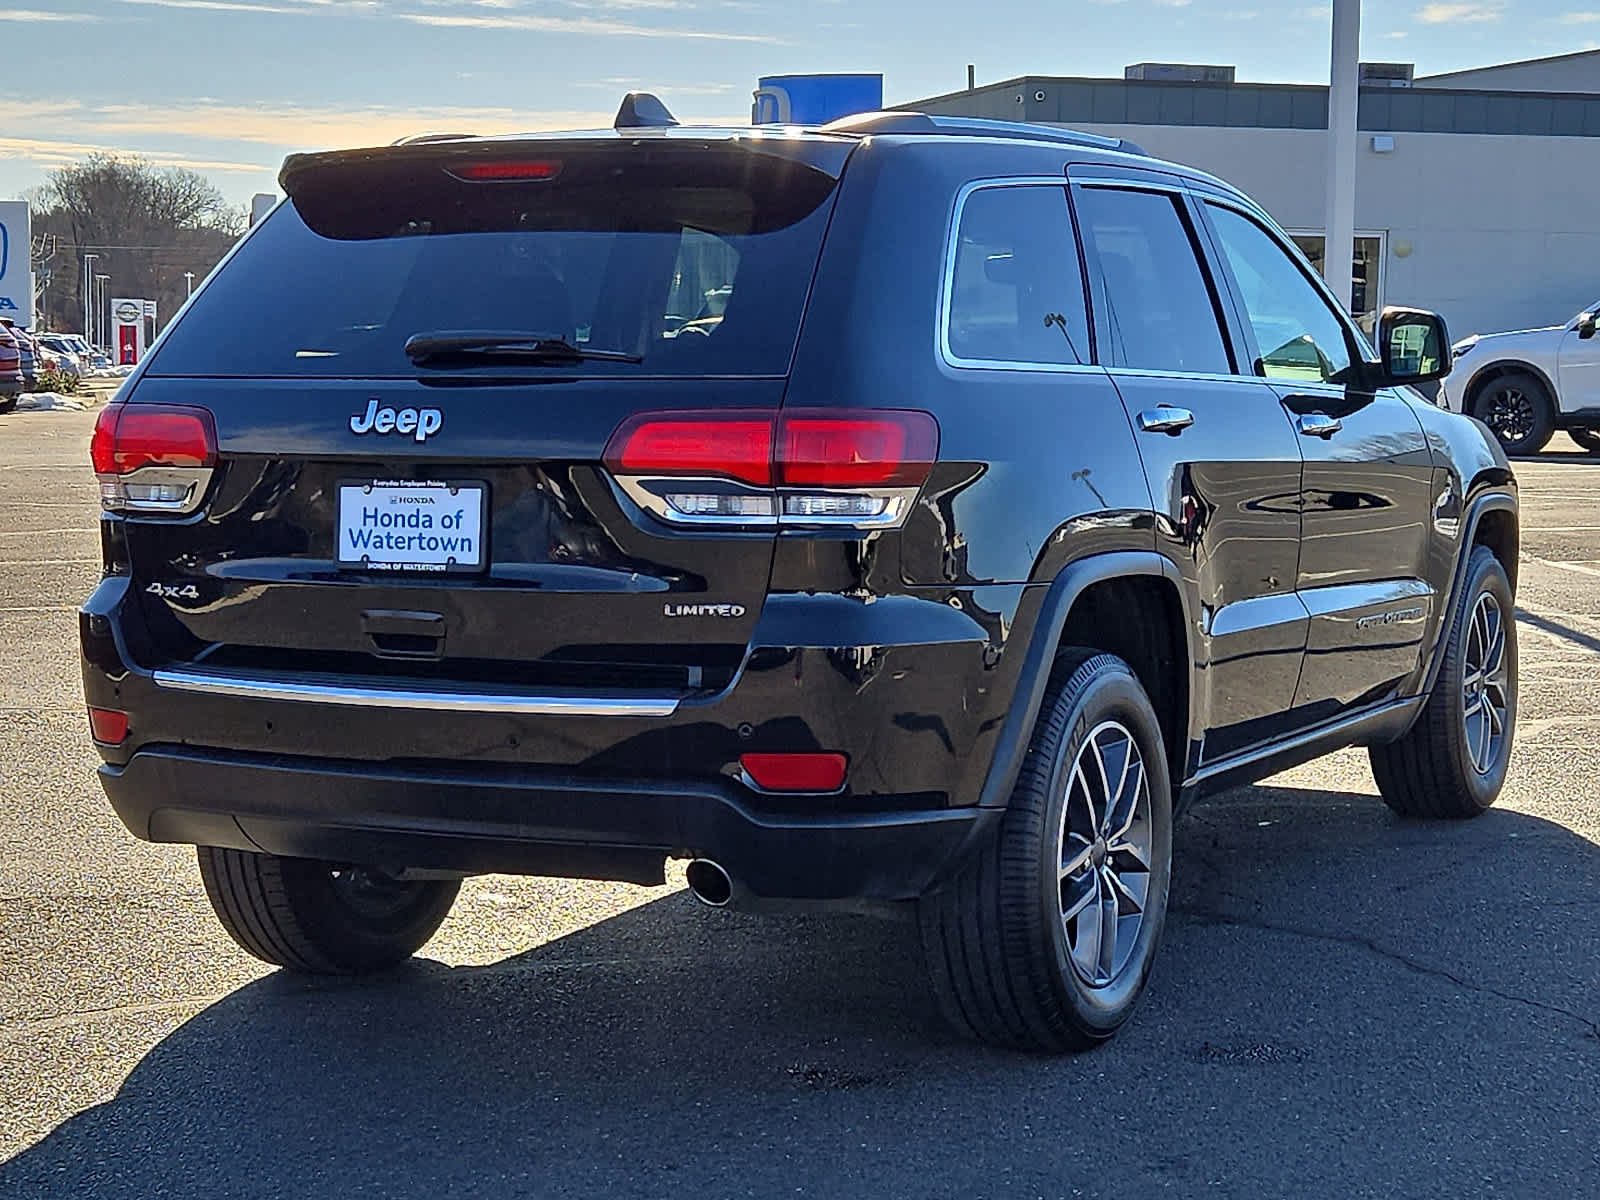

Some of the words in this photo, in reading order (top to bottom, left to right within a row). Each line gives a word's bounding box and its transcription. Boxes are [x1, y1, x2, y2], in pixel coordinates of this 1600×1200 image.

[350, 399, 442, 441] Jeep
[399, 496, 436, 505] HONDA
[363, 507, 433, 529] Honda
[441, 510, 464, 530] of
[348, 528, 472, 552] Watertown
[664, 604, 746, 617] LIMITED
